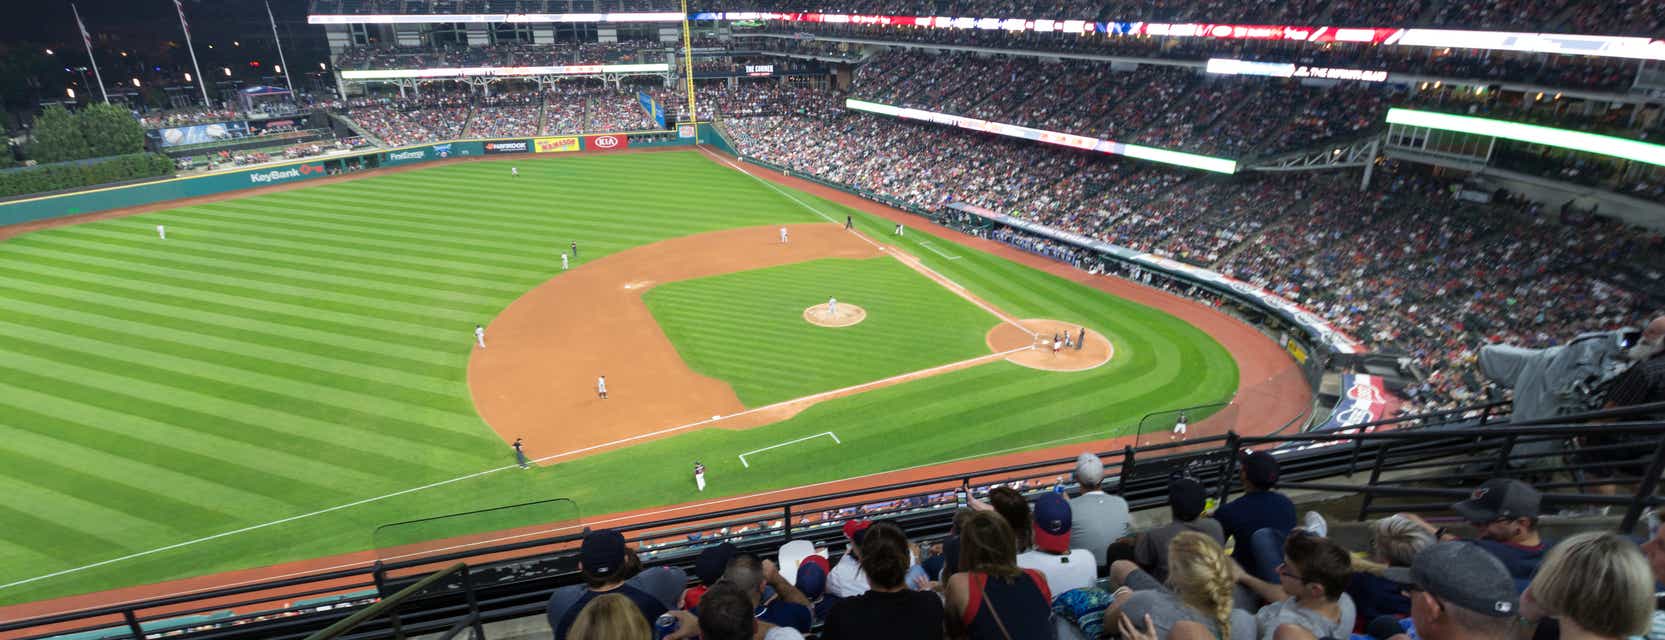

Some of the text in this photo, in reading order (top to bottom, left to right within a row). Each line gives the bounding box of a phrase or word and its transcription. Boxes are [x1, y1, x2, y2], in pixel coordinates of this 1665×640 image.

[745, 64, 774, 73] THE CORNER
[1310, 67, 1328, 78] THE
[250, 167, 300, 183] KeyBank
